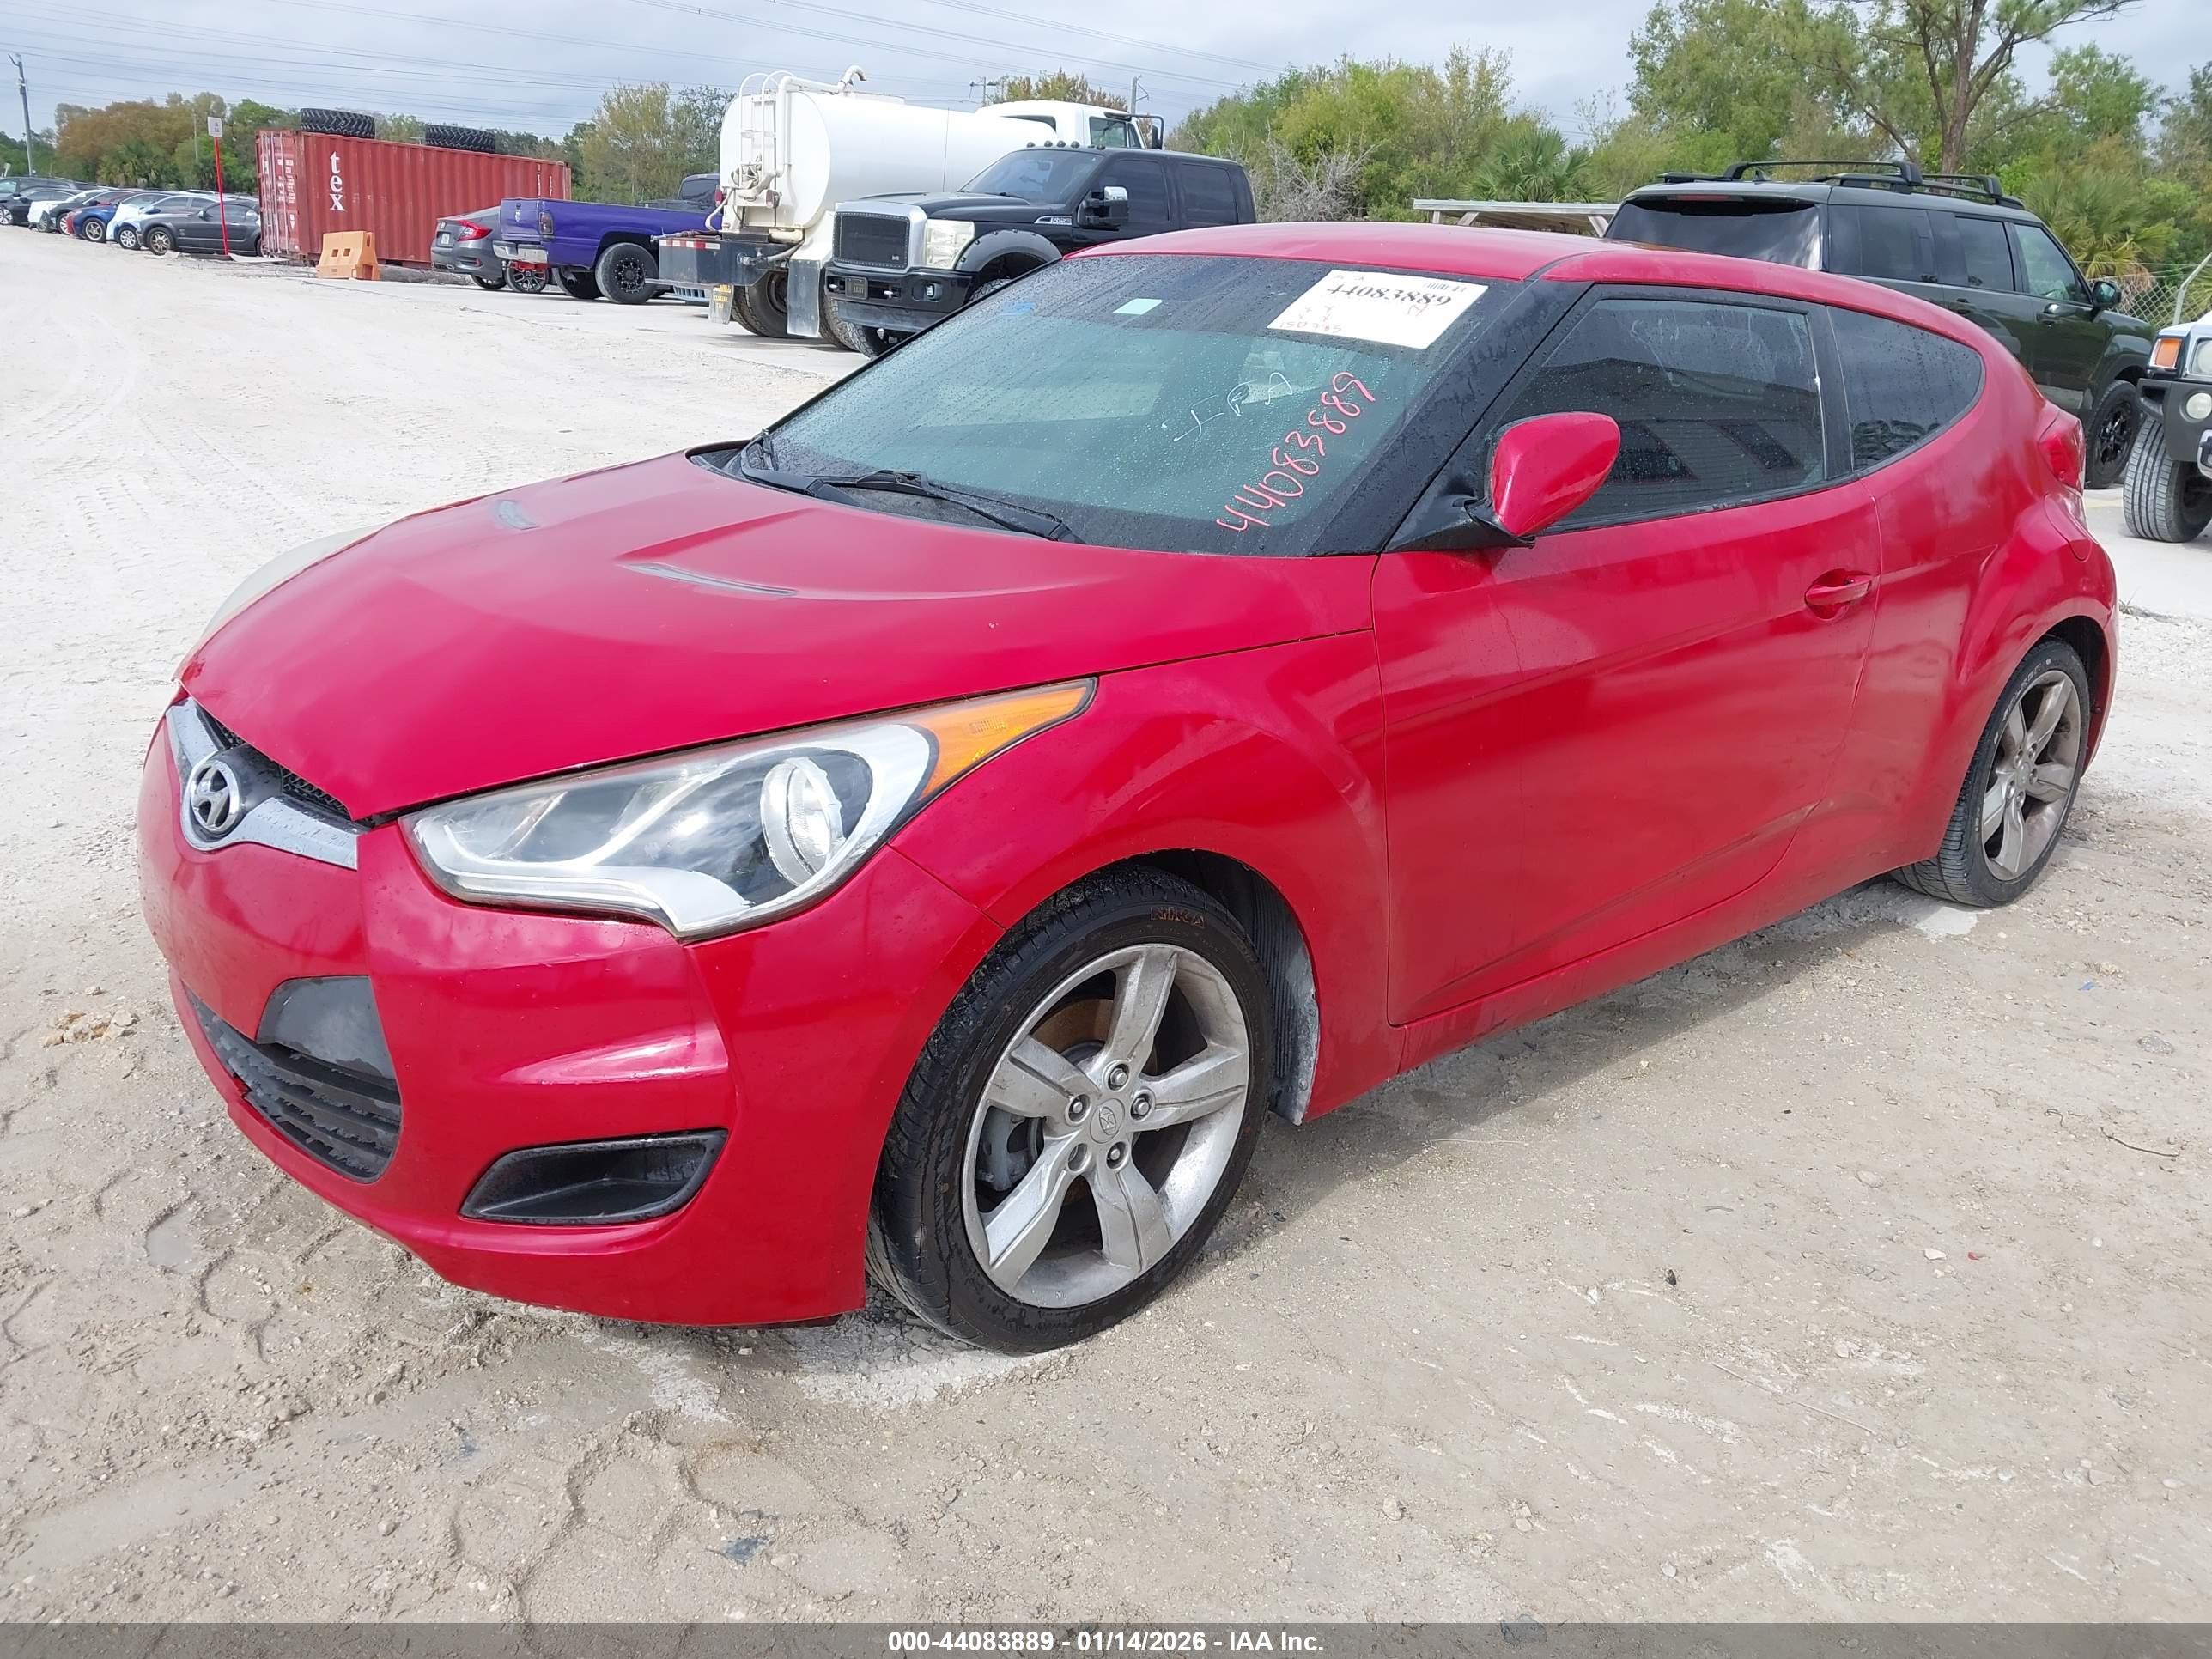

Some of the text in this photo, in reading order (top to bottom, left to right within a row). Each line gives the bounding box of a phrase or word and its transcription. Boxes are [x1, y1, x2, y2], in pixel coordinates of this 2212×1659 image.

[330, 151, 345, 211] tex
[1327, 284, 1452, 307] 44083889
[1216, 372, 1376, 531] 44083889
